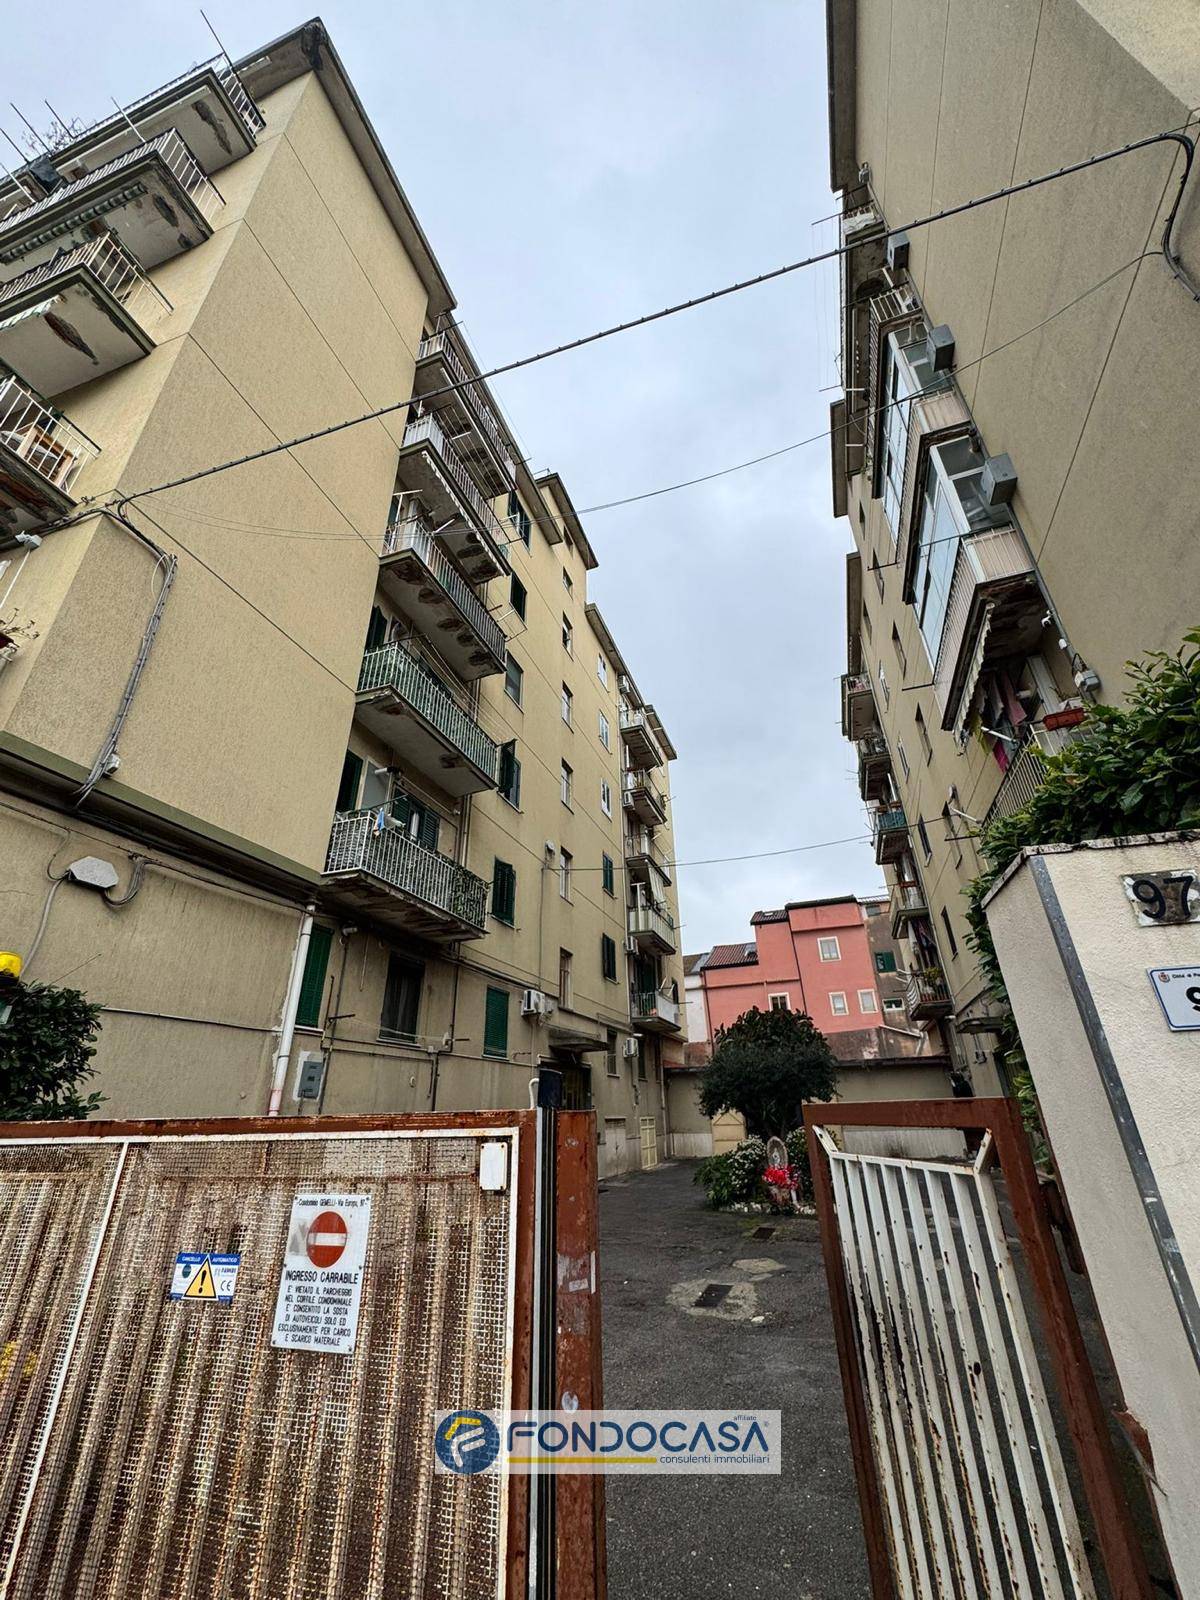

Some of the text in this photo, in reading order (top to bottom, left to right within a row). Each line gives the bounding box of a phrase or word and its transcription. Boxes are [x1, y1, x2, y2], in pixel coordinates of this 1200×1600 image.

[1132, 875, 1195, 919] 97
[285, 1271, 359, 1284] INGRESSO CARRABILE
[322, 1287, 352, 1296] PARCHEGGIO
[297, 1295, 316, 1304] CORTILE
[318, 1296, 352, 1306] CONDOMINIALE
[293, 1305, 321, 1314] CONSENTITO
[333, 1307, 348, 1315] SOSTA
[292, 1315, 322, 1324] AUTOVEICOLI
[324, 1317, 337, 1325] SOLO
[339, 1318, 346, 1326] ED
[278, 1323, 352, 1337] ESCLUSIVAMENTE PER CARICO
[291, 1334, 311, 1344] SCARICO
[314, 1336, 341, 1346] MATERIALE
